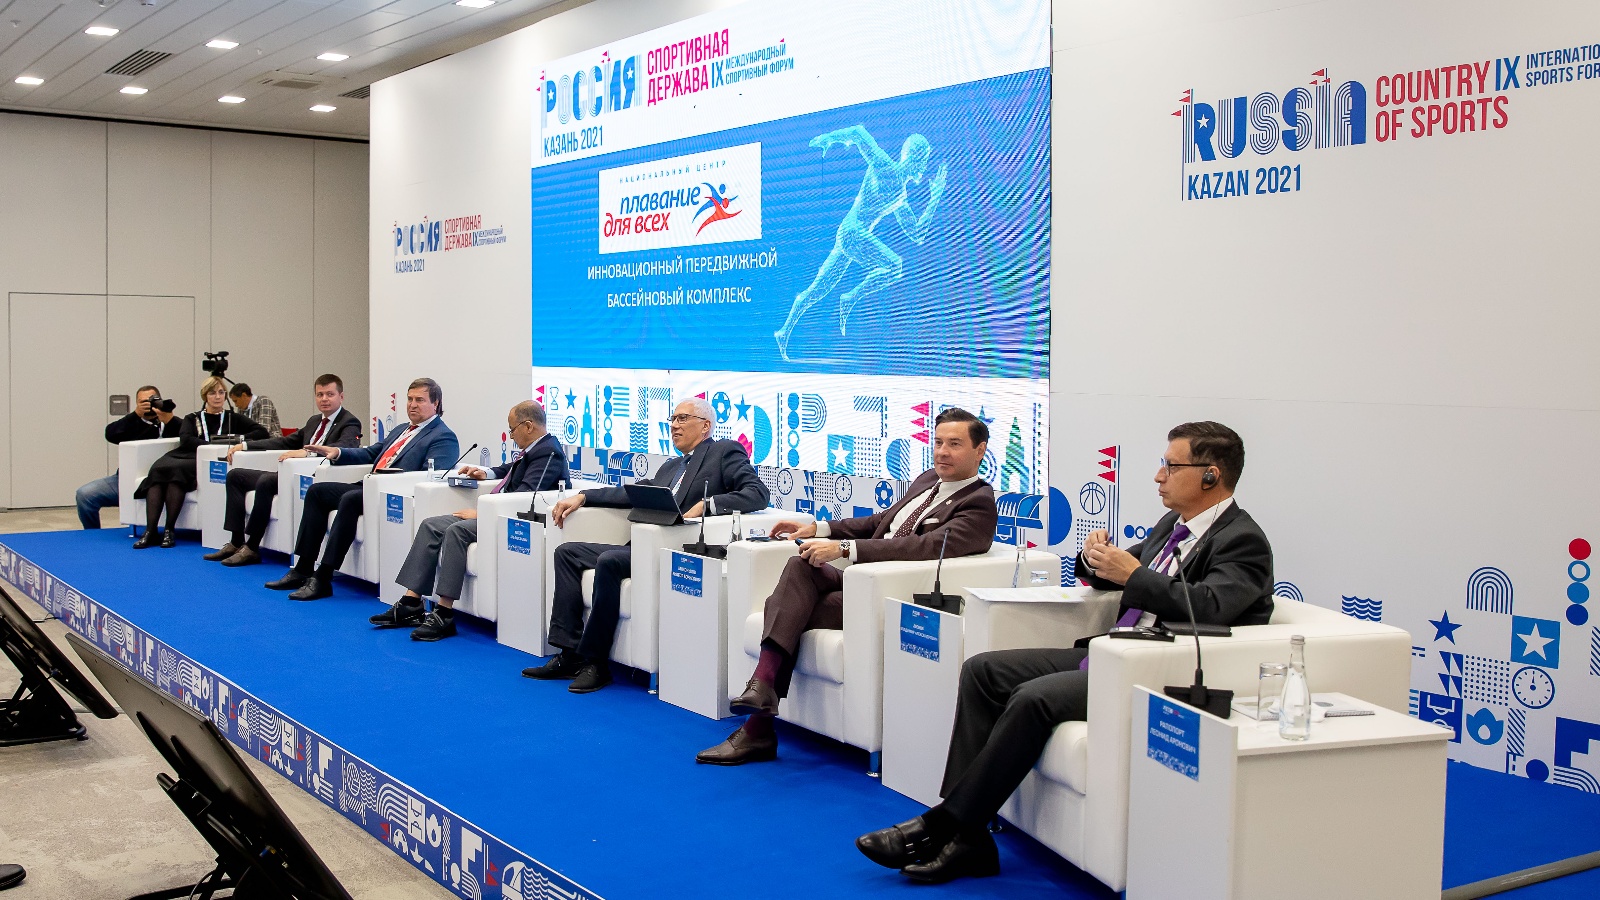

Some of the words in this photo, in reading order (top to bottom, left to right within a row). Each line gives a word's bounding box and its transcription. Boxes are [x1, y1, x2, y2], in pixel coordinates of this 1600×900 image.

[647, 28, 729, 76] СПОРТИВНАЯ
[725, 43, 787, 70] МЕЖДУНАРОДНЫЙ
[1525, 43, 1600, 70] INTERNATIO
[647, 64, 709, 107] ДЕРЖАВА
[711, 60, 724, 89] IX
[725, 63, 768, 85] СПОРТИВНЫЙ
[769, 57, 794, 74] ФОРУМ
[1375, 60, 1490, 107] COUNTRY
[1494, 55, 1521, 92] IX
[1525, 66, 1574, 88] SPORTS
[540, 54, 642, 128] РОССИЯ
[1182, 79, 1367, 163] RUSSIA
[1375, 109, 1402, 143] OF
[1411, 95, 1509, 139] SPORTS
[544, 131, 579, 158] КАЗАНЬ
[580, 125, 603, 150] 2021
[1188, 169, 1249, 201] KAZAN
[1255, 163, 1301, 195] 2021
[620, 186, 701, 215] плавание
[394, 220, 442, 256] РОССИЯ
[444, 214, 482, 234] СПОРТИВНАЯ
[603, 212, 632, 237] для
[634, 211, 671, 234] всех
[444, 232, 473, 253] ДЕРЖАВА
[413, 259, 425, 272] 2021
[587, 255, 683, 280] ИННОВАЦИОННЫЙ
[685, 247, 778, 275] ПЕРЕДВИЖНОЙ
[607, 286, 684, 308] БАССЕЙНОВЫЙ
[686, 286, 752, 305] КОМПЛЕКС
